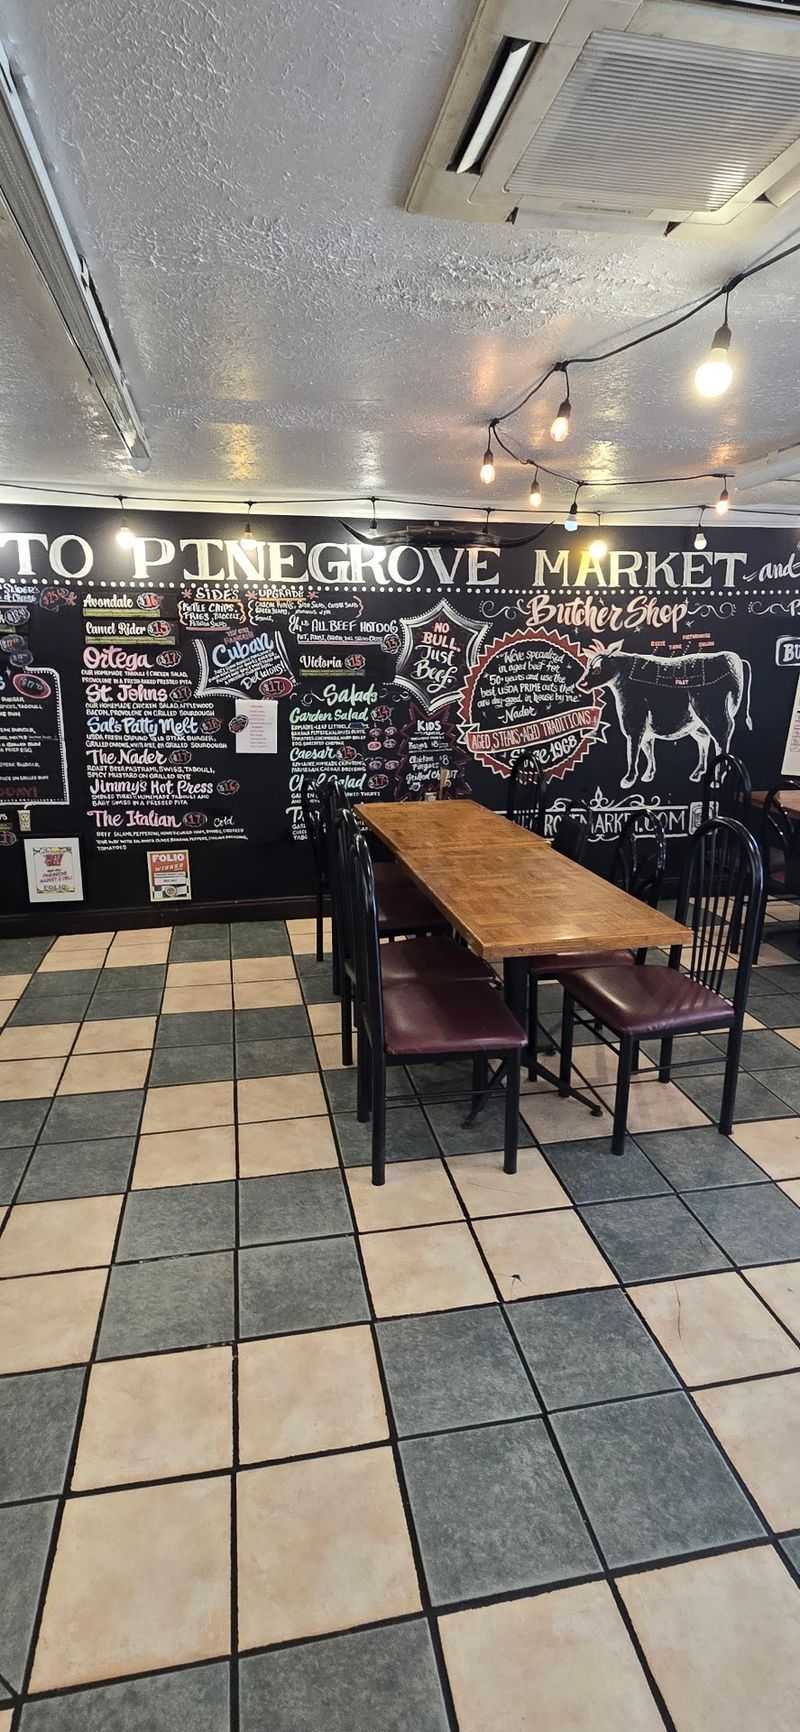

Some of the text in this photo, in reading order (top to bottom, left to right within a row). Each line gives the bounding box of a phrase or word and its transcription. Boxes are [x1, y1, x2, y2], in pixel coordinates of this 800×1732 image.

[0, 532, 800, 588] TO PINEGROVE MARKET and
[83, 593, 134, 608] Avondale
[525, 594, 690, 633] Butcher Shop
[86, 621, 116, 635] Camel
[117, 622, 146, 636] Rider
[312, 619, 329, 632] ALL
[329, 620, 357, 632] BEEF
[434, 622, 450, 633] NO
[83, 645, 154, 671] Ortega
[212, 633, 274, 667] Cuban
[415, 644, 454, 666] Just
[300, 655, 343, 668] Victoria
[504, 673, 525, 682] years
[526, 673, 539, 681] and
[553, 673, 566, 683] the
[85, 683, 114, 703] St.
[117, 684, 168, 702] Johns
[323, 683, 378, 706] Salads
[480, 687, 496, 697] best
[498, 685, 518, 695] USDA
[520, 683, 541, 693] PRIME
[289, 707, 333, 723] Garden
[334, 707, 369, 721] Salad
[87, 717, 122, 733] Sal's
[121, 717, 158, 736] Patty
[159, 717, 199, 736] Melt
[417, 720, 442, 731] KIDS
[472, 733, 491, 750] AGED
[543, 710, 591, 737] TRADITIONS
[290, 746, 337, 761] Caesar
[551, 735, 578, 762] 1968
[85, 749, 117, 765] The
[117, 749, 167, 765] Nader
[89, 779, 147, 796] Jimmy's
[151, 780, 174, 795] Hot
[177, 780, 213, 799] Press
[86, 810, 124, 827] The
[125, 811, 182, 827] Italian
[152, 853, 185, 863] FOLIO
